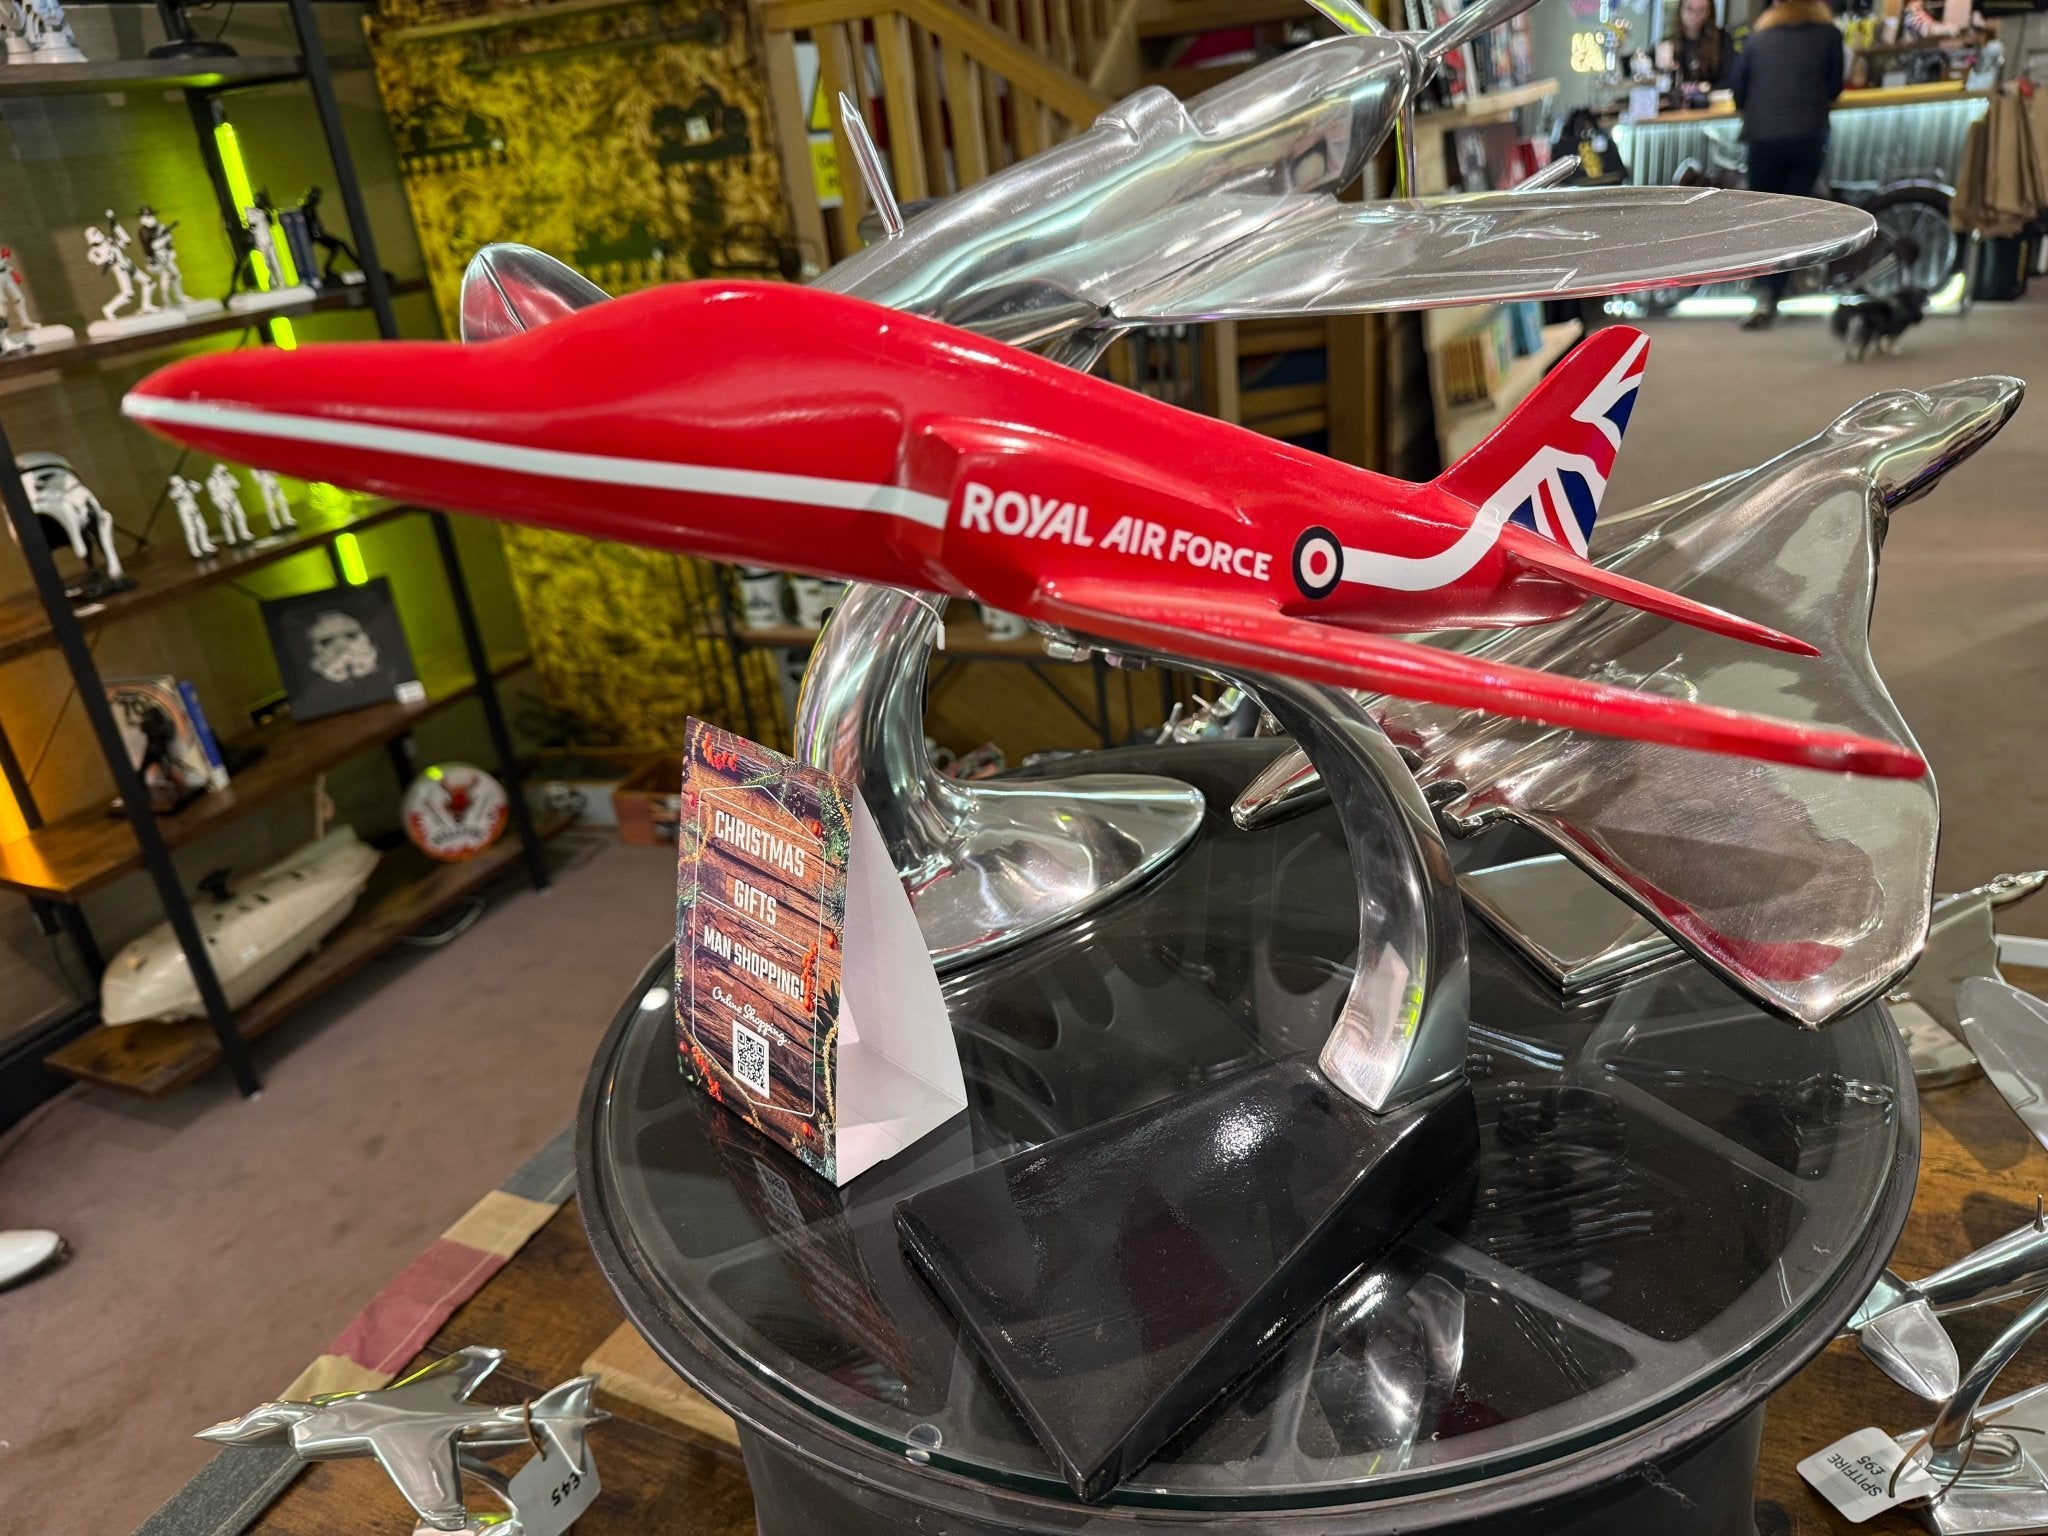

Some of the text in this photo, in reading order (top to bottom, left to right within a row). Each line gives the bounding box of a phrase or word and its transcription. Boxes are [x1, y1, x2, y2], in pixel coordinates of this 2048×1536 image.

[960, 482, 1273, 581] ROYAL AIR FORCE
[715, 810, 805, 878] CHRISTMAS
[734, 879, 777, 926] GIFTS
[704, 925, 805, 1003] MAN SHOPPING!
[712, 986, 743, 1013] Online
[1827, 1453, 1882, 1497] SPITFIRE
[1856, 1455, 1886, 1475] £95
